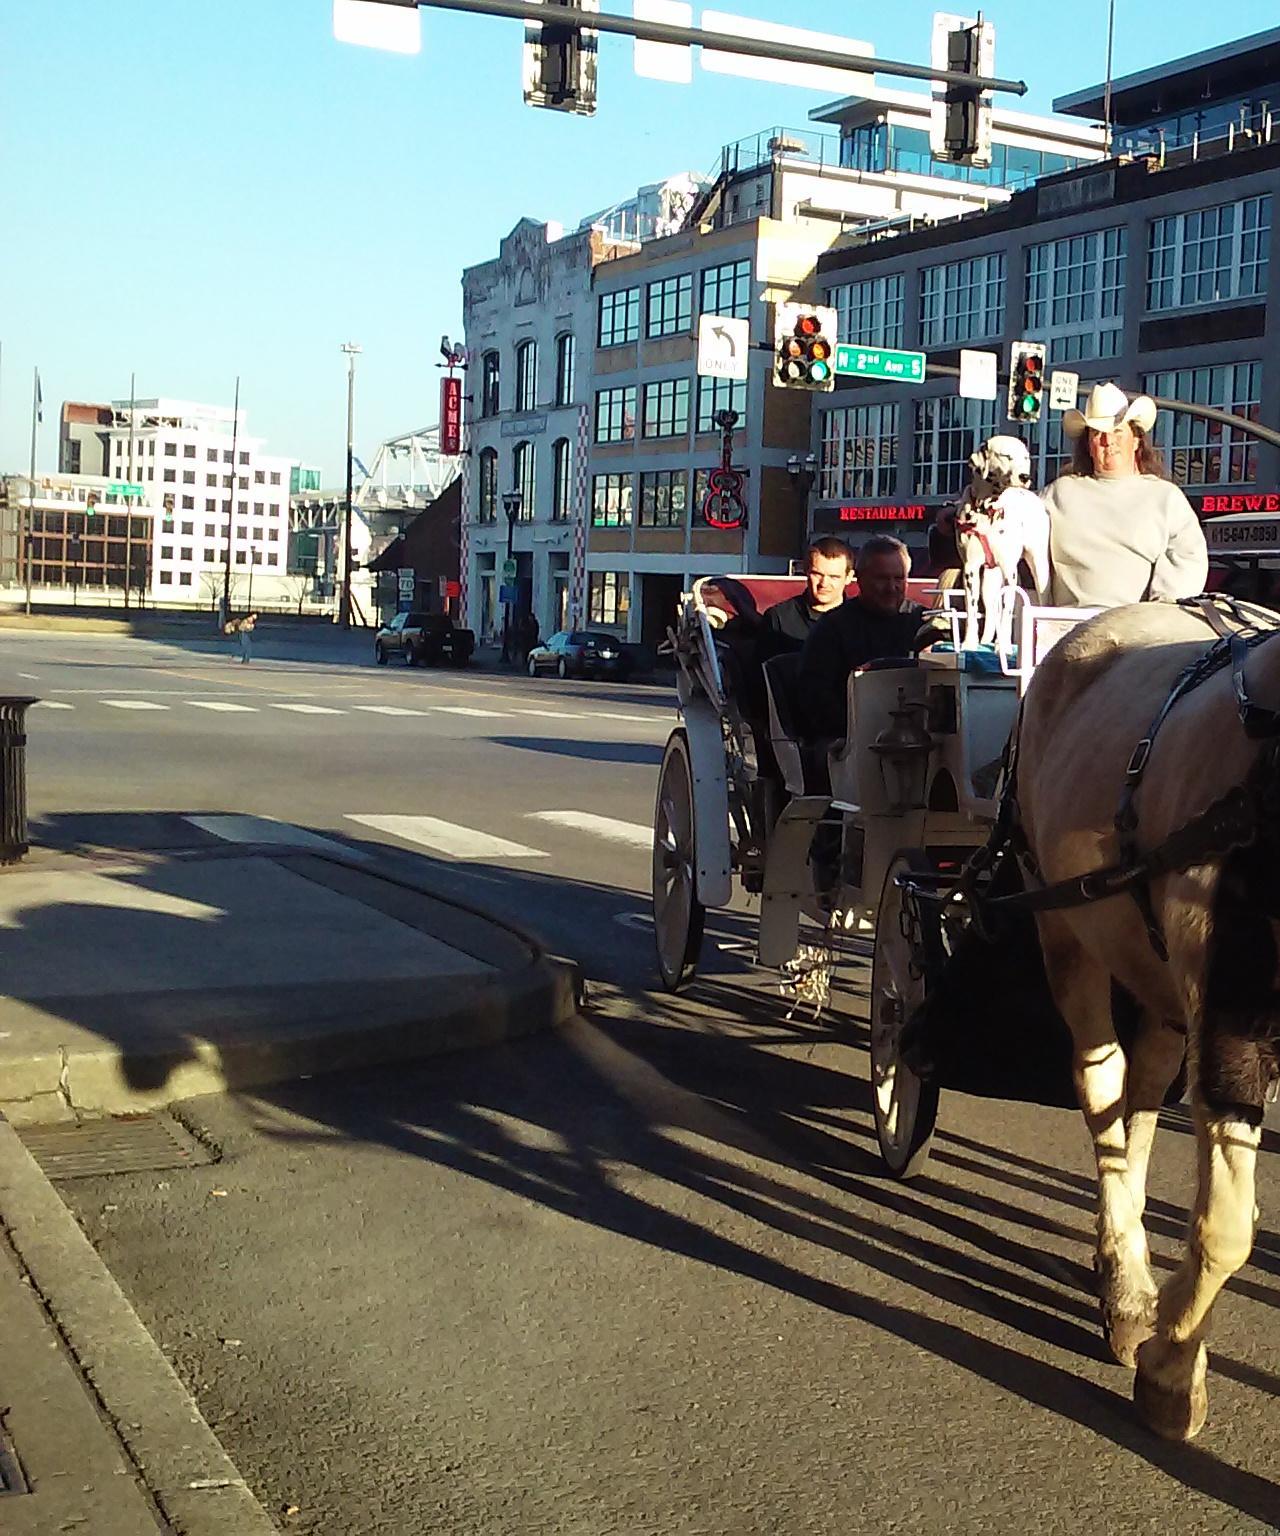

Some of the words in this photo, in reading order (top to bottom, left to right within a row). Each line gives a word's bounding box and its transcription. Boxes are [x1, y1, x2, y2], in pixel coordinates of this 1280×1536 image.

[705, 358, 738, 372] ONLY
[838, 352, 849, 368] N
[856, 354, 880, 370] 2nd
[884, 360, 904, 373] Ave
[911, 360, 921, 376] S
[1056, 376, 1073, 386] ONE
[1054, 387, 1072, 396] WAY
[447, 382, 458, 438] ACME
[839, 505, 926, 521] RESTAURANT
